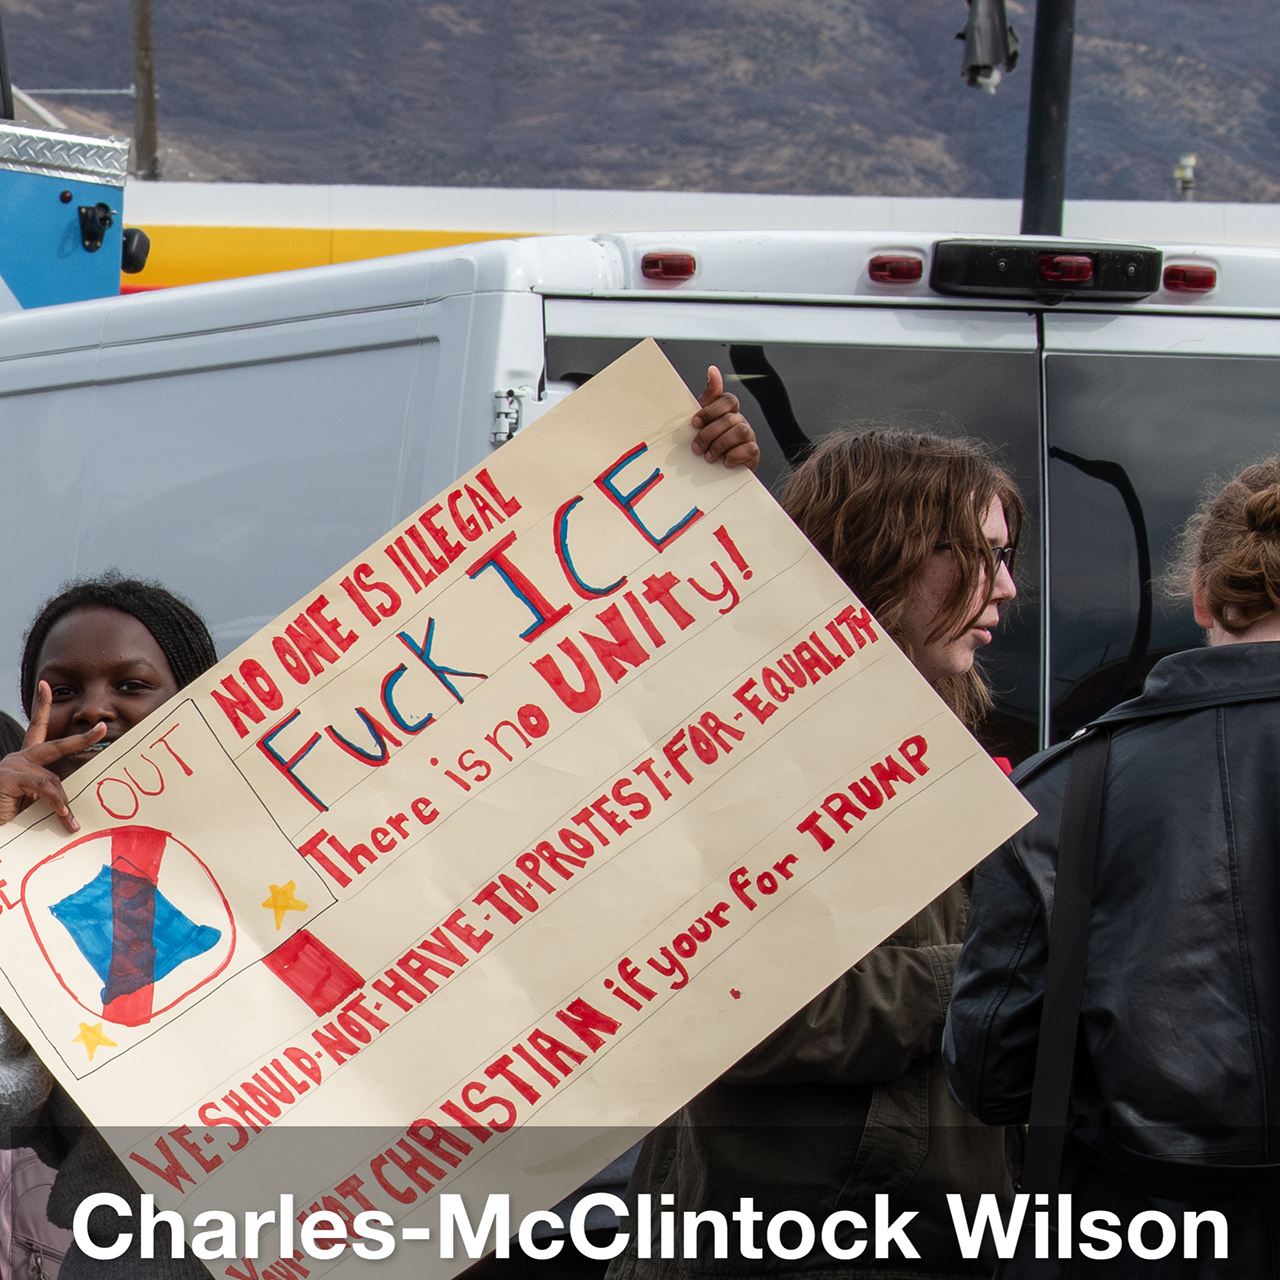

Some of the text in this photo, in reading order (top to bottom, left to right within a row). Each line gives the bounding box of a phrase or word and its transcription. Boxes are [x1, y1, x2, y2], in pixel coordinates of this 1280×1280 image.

[210, 467, 523, 739] NO ONE IS ILLEGAL
[465, 441, 705, 644] ICE
[96, 723, 194, 820] OUT
[298, 796, 440, 888] There
[430, 745, 493, 792] is
[484, 702, 550, 762] no
[369, 997, 622, 1205] CHRISTIAN
[603, 957, 658, 1012] if
[646, 900, 731, 990] your
[795, 734, 930, 853] TRUMP
